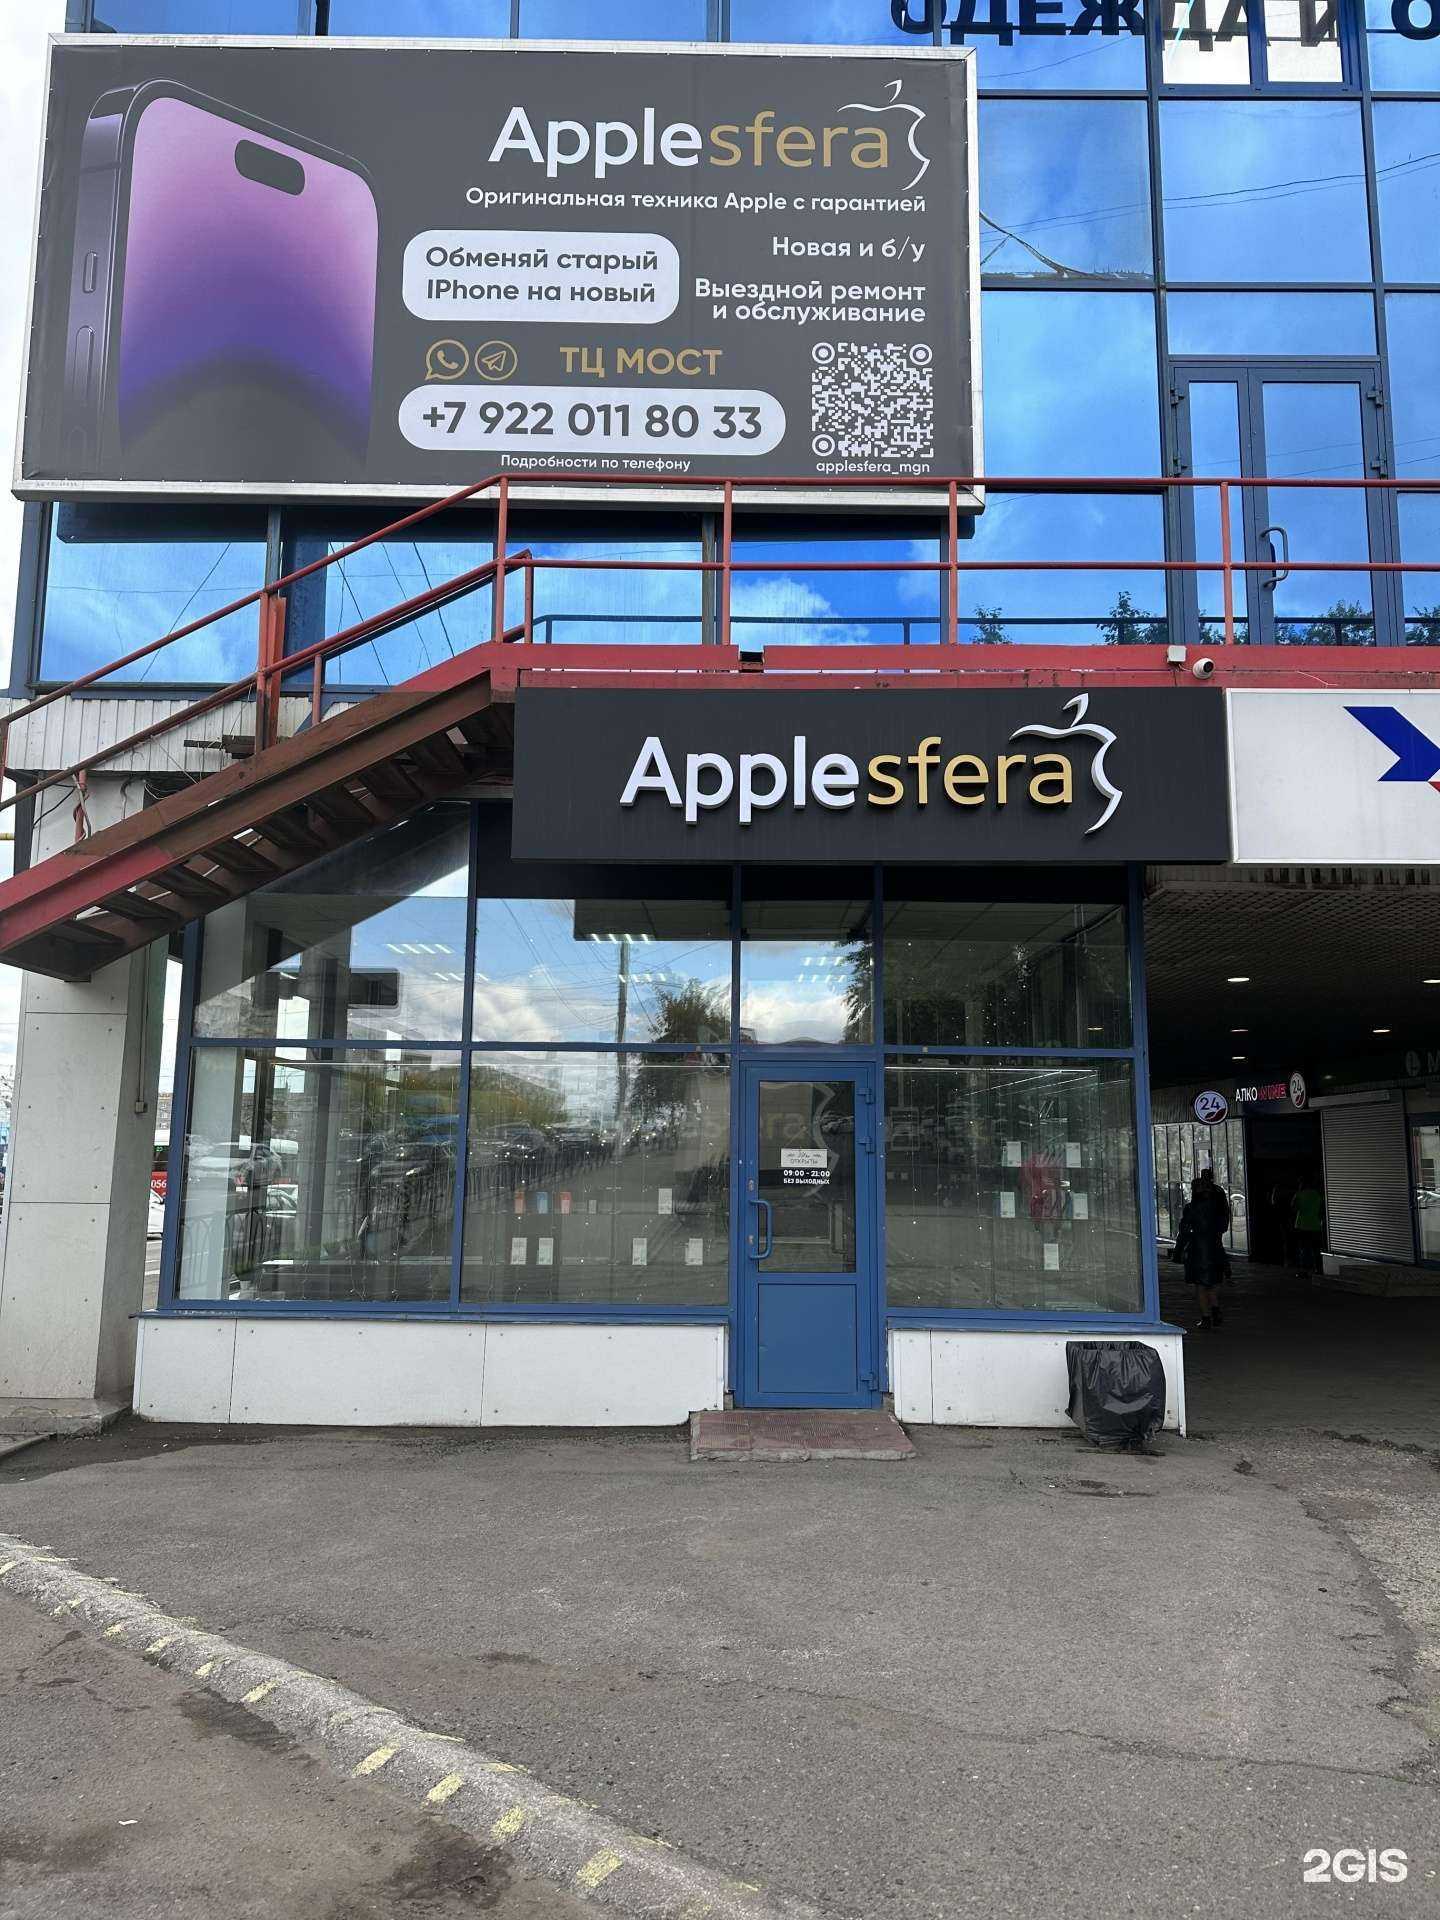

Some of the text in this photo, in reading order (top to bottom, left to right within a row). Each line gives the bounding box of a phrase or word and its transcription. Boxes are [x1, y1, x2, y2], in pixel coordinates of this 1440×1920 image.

[488, 105, 890, 178] Applesfera
[465, 186, 926, 214] Оригинальная техника Apple с гарантией
[425, 246, 658, 275] Обменяй старый
[772, 235, 926, 262] Новая и б/у
[427, 278, 655, 303] IPhone на новый
[695, 277, 926, 305] Выездной ремонт
[712, 300, 926, 325] и обслуживание
[559, 346, 723, 379] ТЦ МОСТ
[422, 401, 763, 440] +7 922 011 80 33
[500, 454, 691, 473] Подробности по телефону
[816, 461, 931, 476] applesfera_mgn
[619, 735, 1074, 827] Applesfera
[1199, 1096, 1221, 1111] 24
[783, 1169, 805, 1177] 09:00
